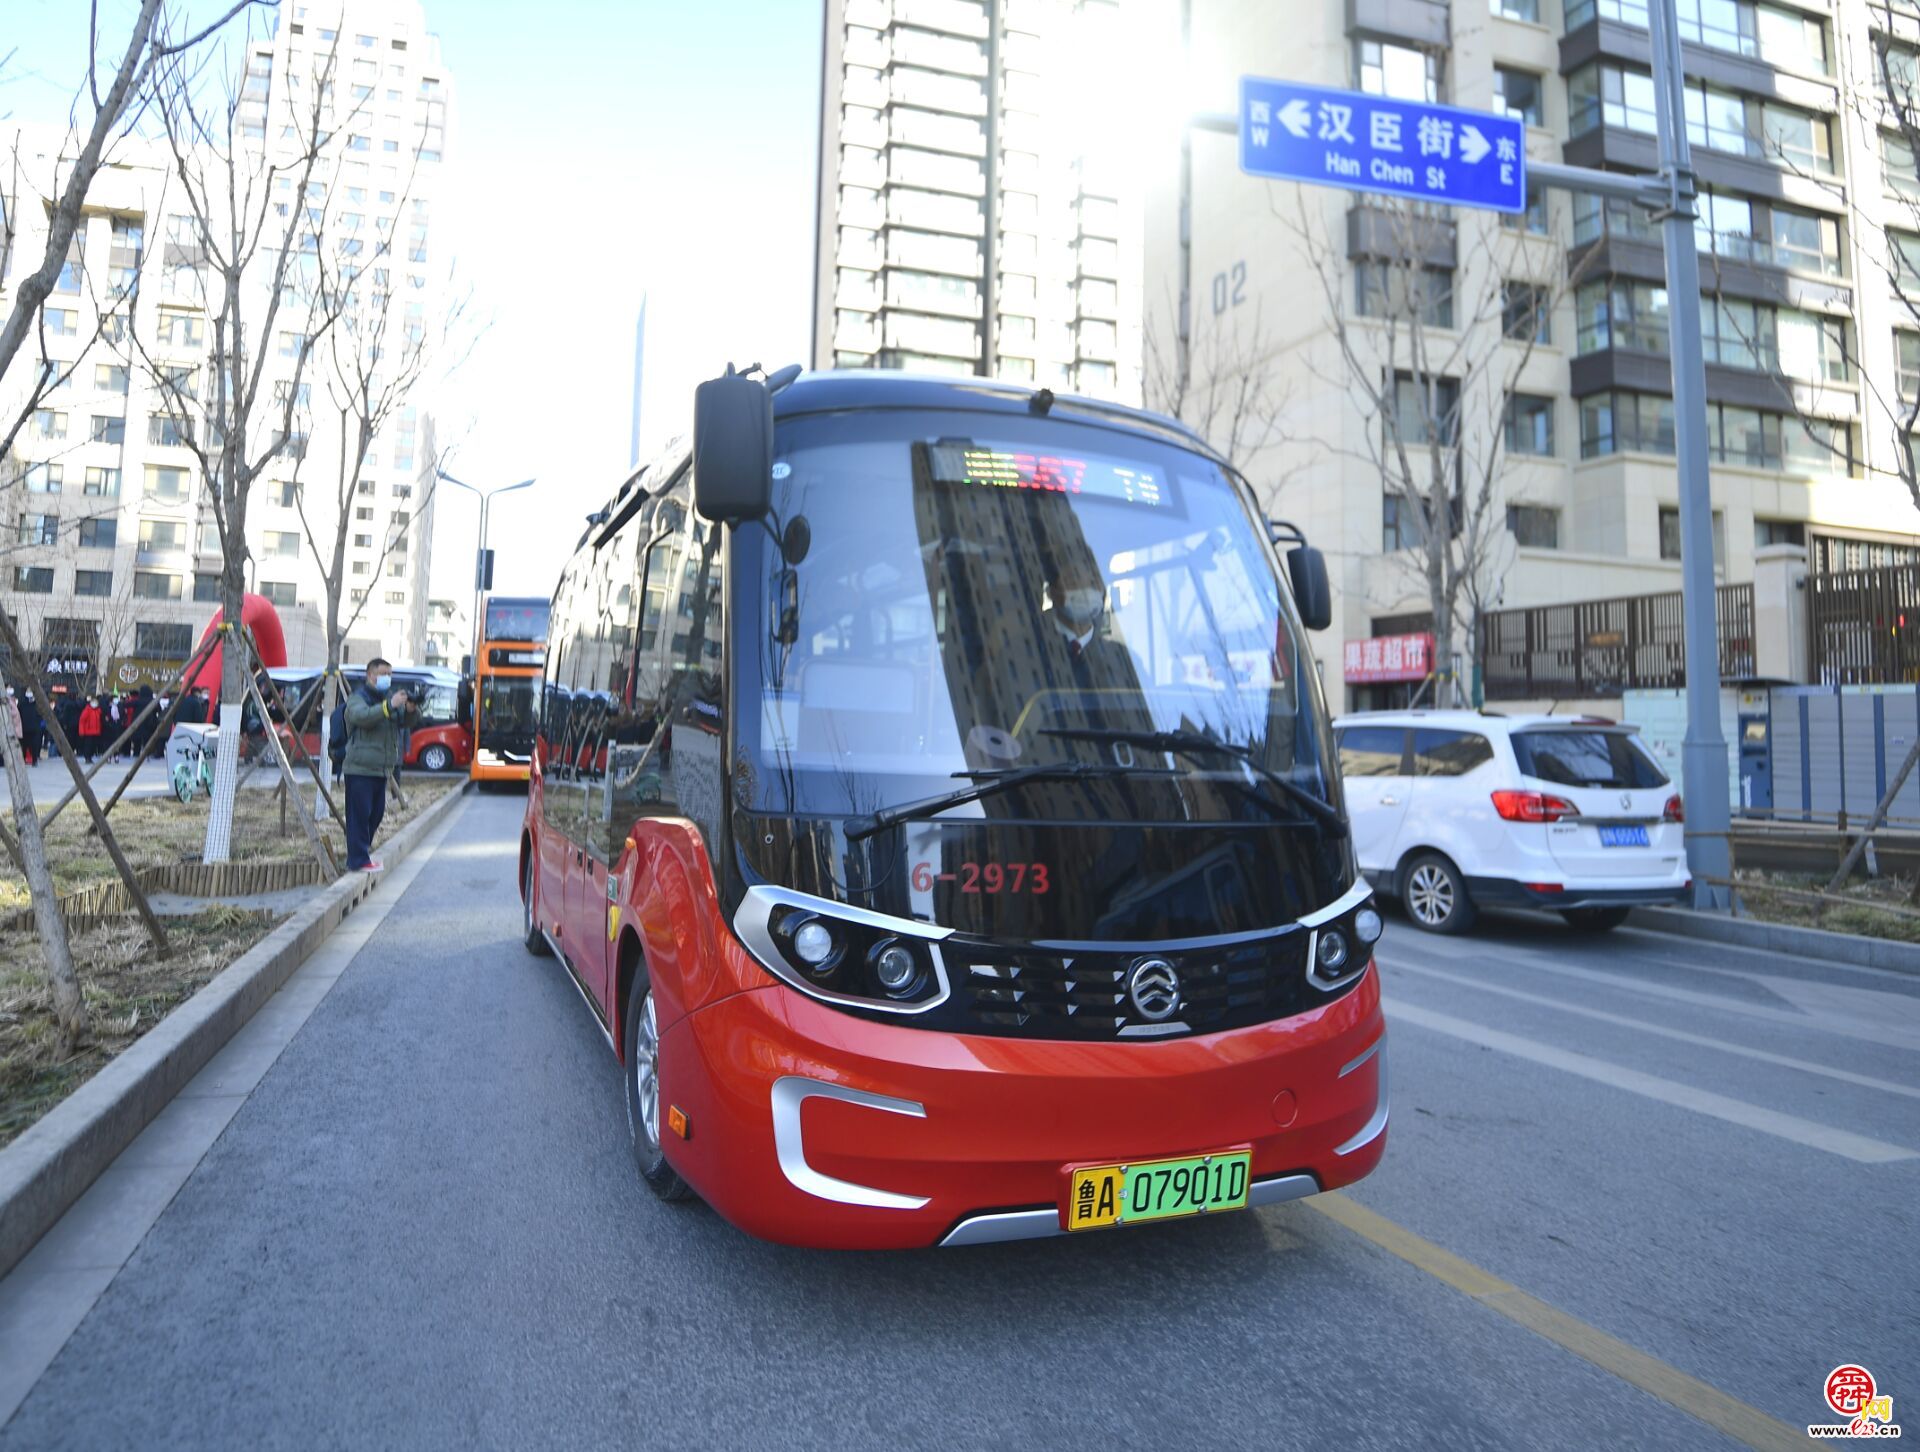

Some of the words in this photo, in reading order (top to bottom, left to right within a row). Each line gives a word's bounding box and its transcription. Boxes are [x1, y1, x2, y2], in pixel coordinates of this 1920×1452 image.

[1251, 126, 1269, 147] W
[1318, 102, 1454, 159] 汉臣街
[1496, 136, 1516, 161] 东
[1325, 151, 1361, 177] Han
[1370, 157, 1415, 186] Chen
[1426, 165, 1446, 190] St
[1500, 163, 1514, 186] E
[1212, 260, 1247, 316] 02
[911, 862, 1050, 894] 6-2973
